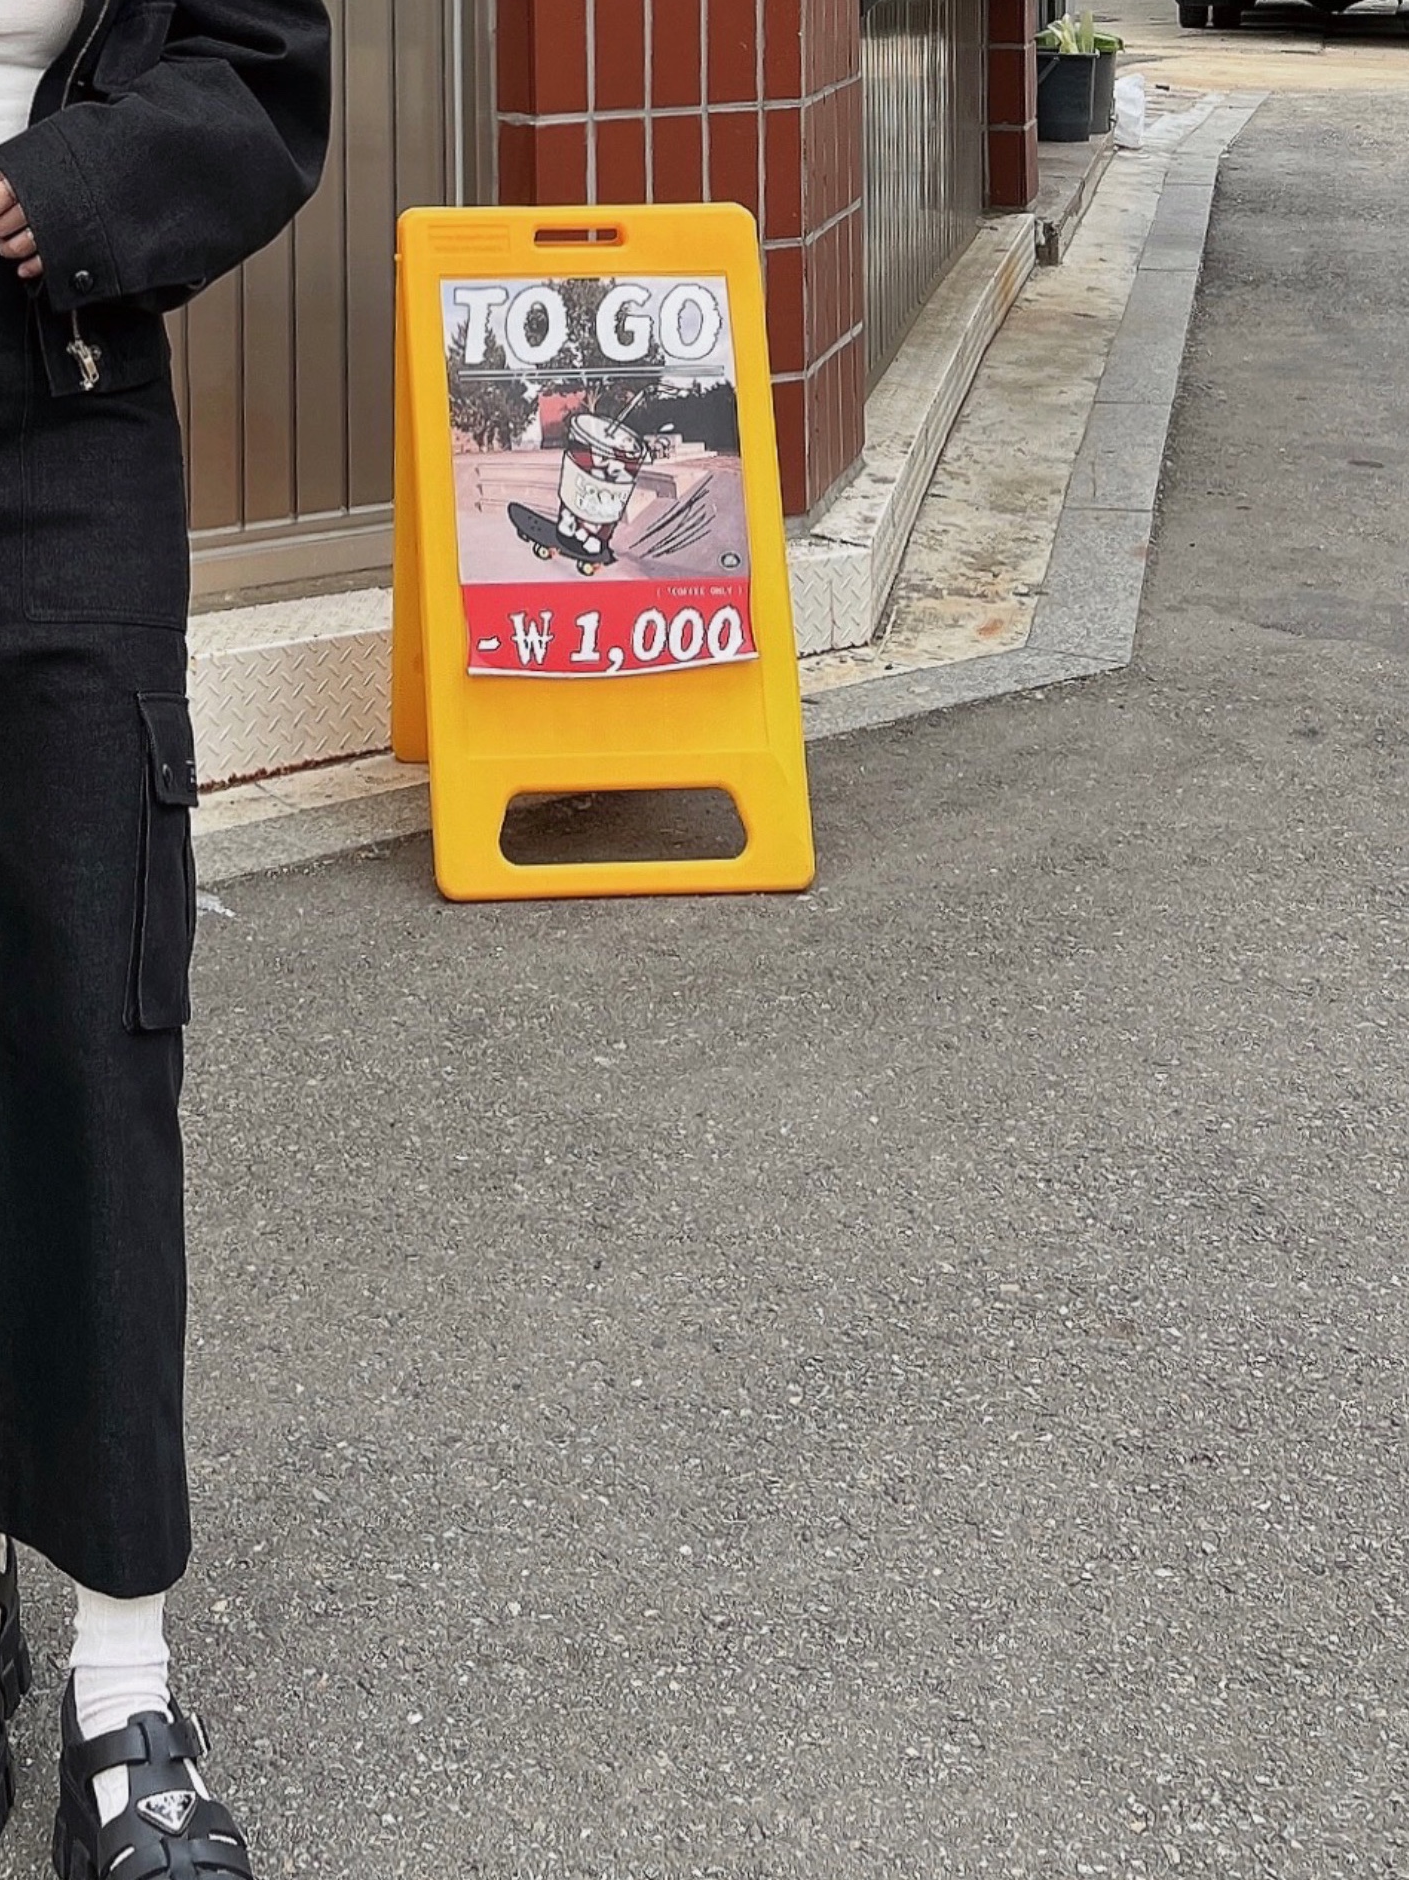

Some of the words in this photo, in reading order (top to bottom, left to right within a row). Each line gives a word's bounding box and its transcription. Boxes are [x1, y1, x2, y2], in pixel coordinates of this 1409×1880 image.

[453, 283, 571, 367] TO
[594, 282, 725, 364] GO
[569, 605, 746, 674] 1,000
